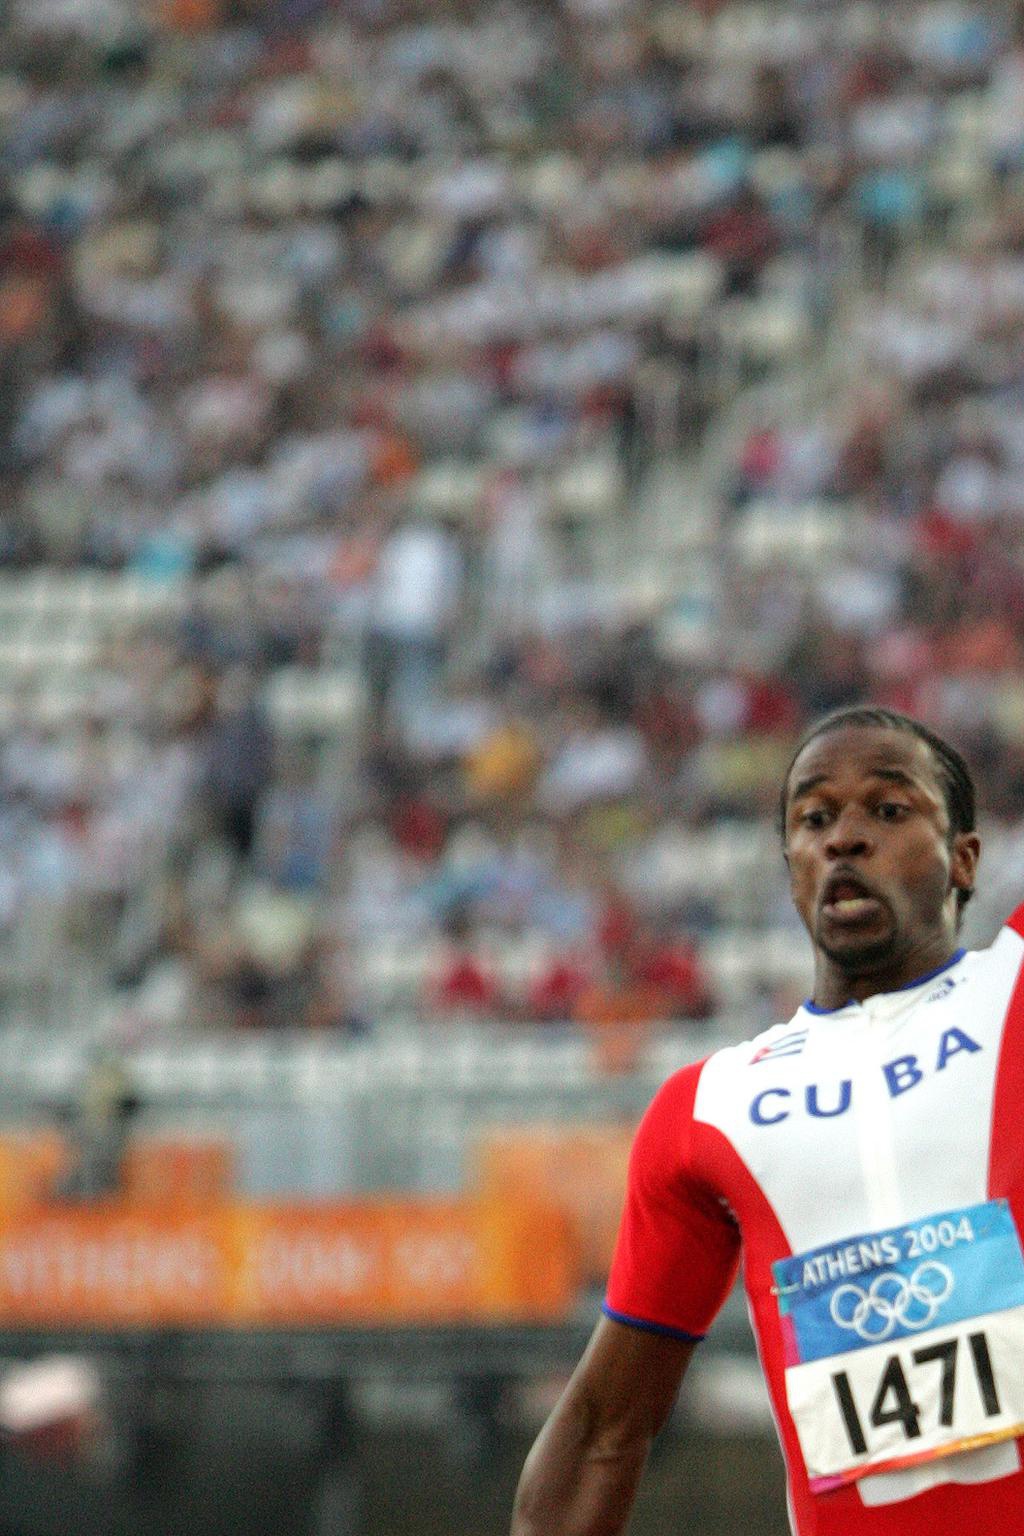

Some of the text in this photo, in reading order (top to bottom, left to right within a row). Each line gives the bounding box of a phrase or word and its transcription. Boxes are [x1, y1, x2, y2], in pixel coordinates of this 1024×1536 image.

[749, 1026, 983, 1126] CUBA
[802, 1216, 975, 1289] ATHENS 2004
[831, 1331, 1001, 1455] 1471
